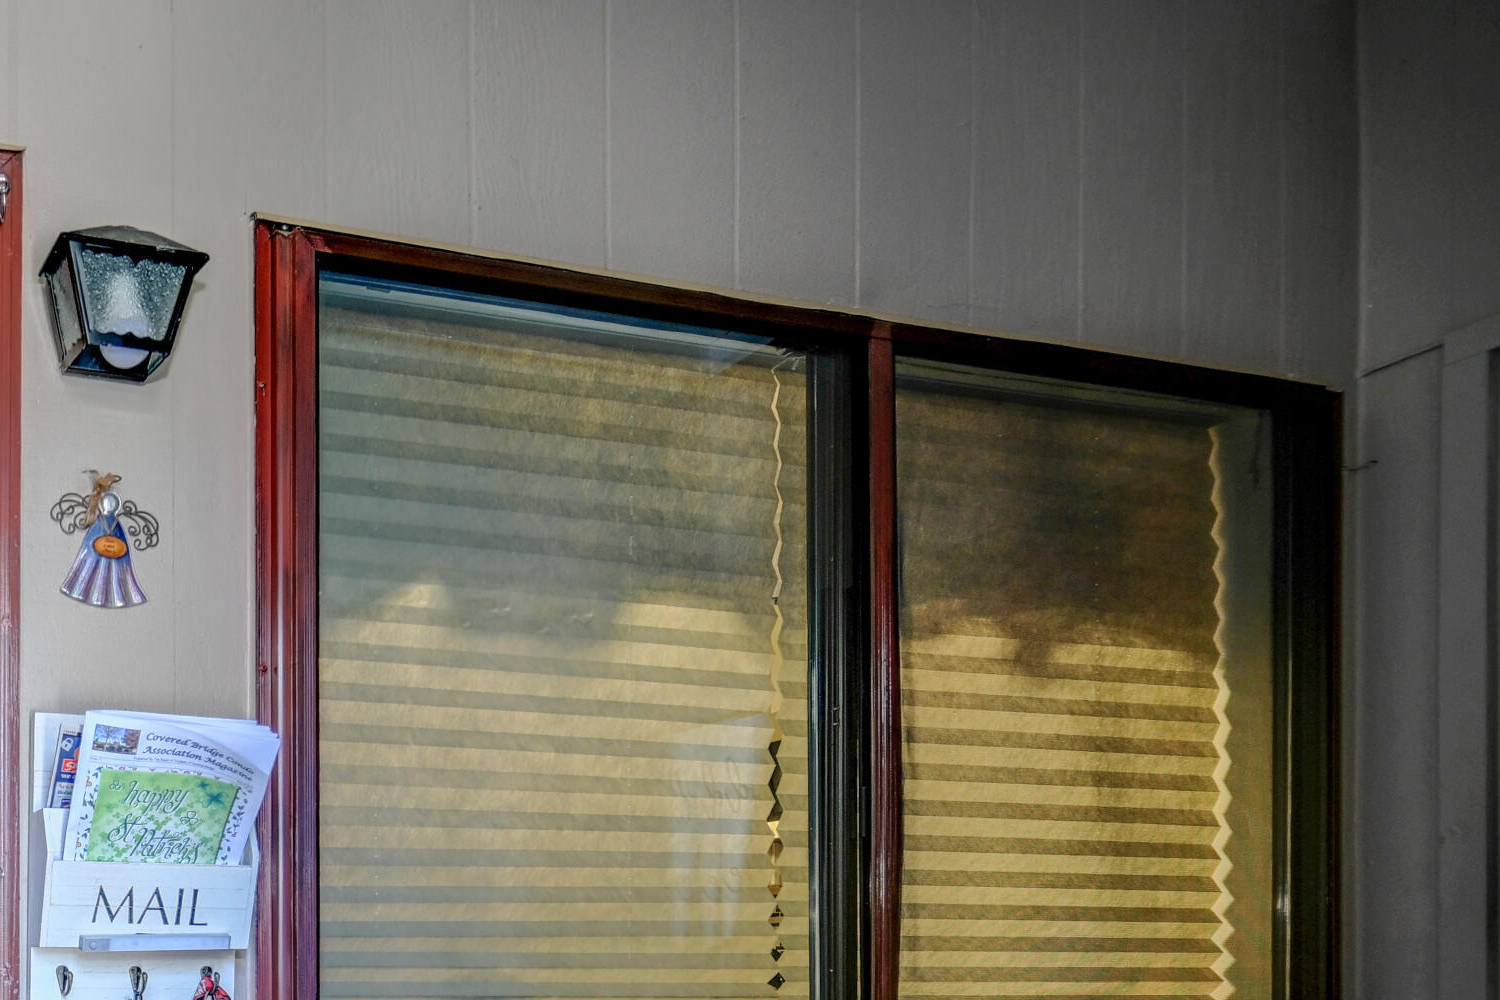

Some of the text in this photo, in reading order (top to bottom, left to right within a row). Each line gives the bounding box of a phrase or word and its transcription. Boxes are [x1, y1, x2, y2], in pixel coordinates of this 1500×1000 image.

[146, 732, 190, 746] Covered
[190, 740, 224, 758] Bridge
[142, 745, 202, 761] Association
[204, 757, 253, 781] Magazine
[124, 780, 190, 815] happy
[91, 884, 208, 926] MAIL
